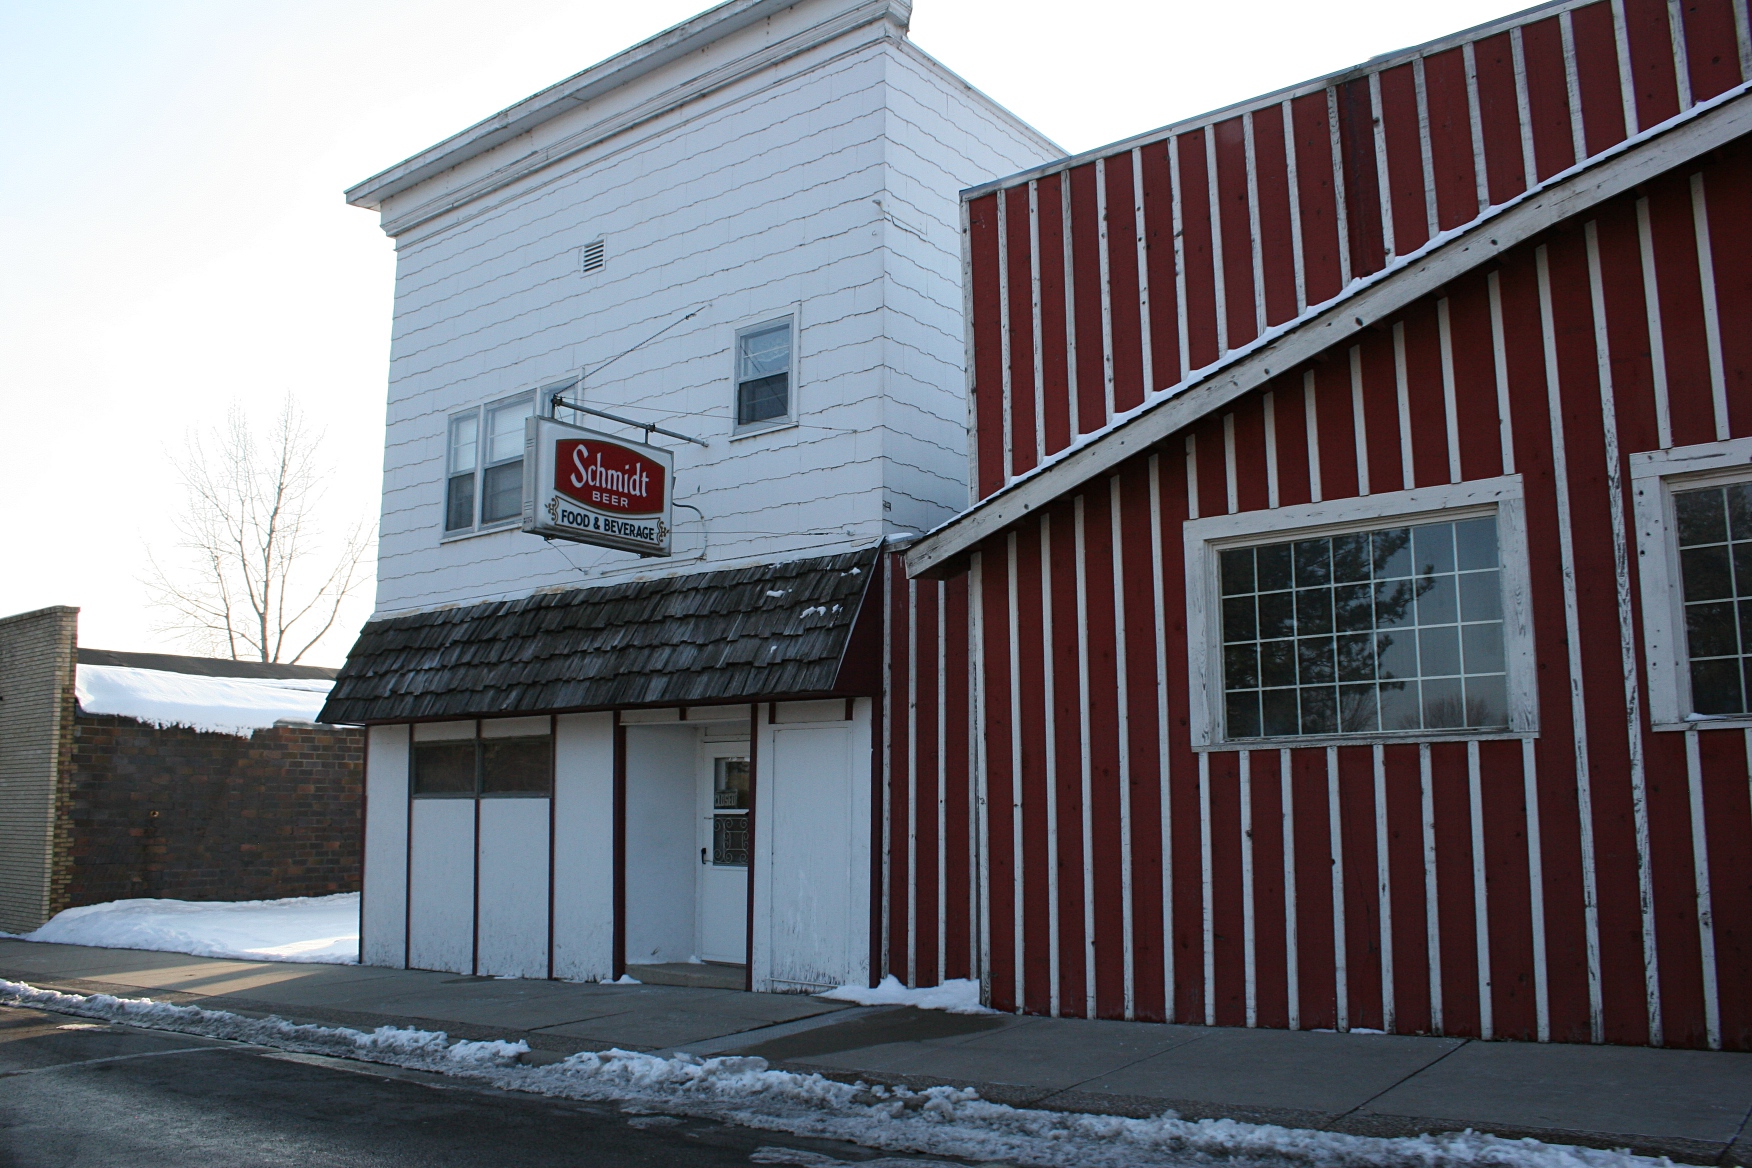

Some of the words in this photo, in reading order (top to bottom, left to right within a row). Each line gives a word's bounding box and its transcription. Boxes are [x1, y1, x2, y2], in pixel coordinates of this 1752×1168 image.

[570, 444, 649, 498] Schmidt
[592, 490, 629, 508] BEER
[561, 509, 591, 528] FOOD
[593, 518, 601, 530] &
[603, 519, 655, 541] BEVERAGE
[715, 794, 736, 806] CLOSED
